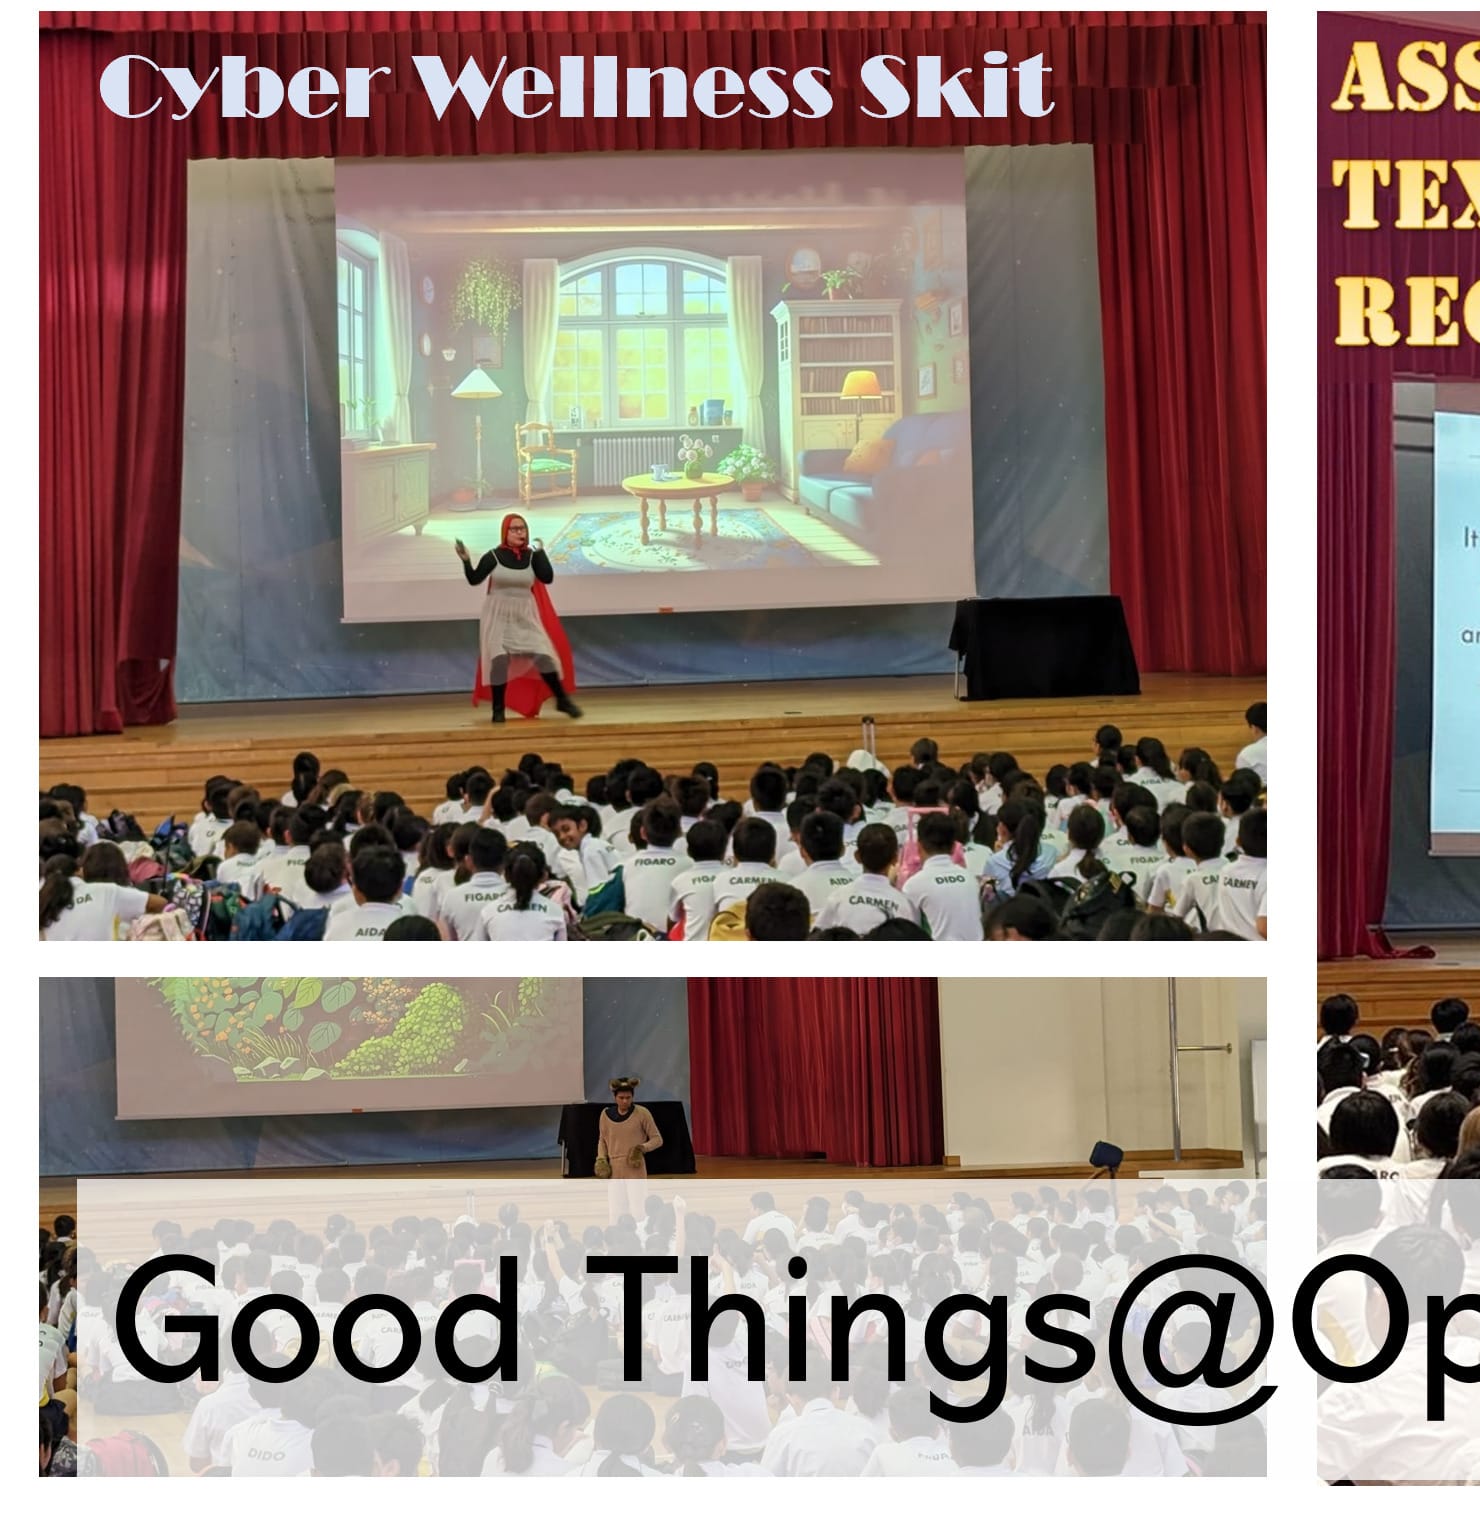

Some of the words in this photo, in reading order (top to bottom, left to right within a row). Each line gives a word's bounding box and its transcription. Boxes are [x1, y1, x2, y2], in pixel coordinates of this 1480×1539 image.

[1464, 526, 1479, 548] It
[634, 857, 676, 867] FIGARO
[935, 874, 966, 884] DIDO
[848, 895, 899, 910] CARMEN
[356, 927, 387, 937] AIDA
[247, 1447, 286, 1462] DIDO
